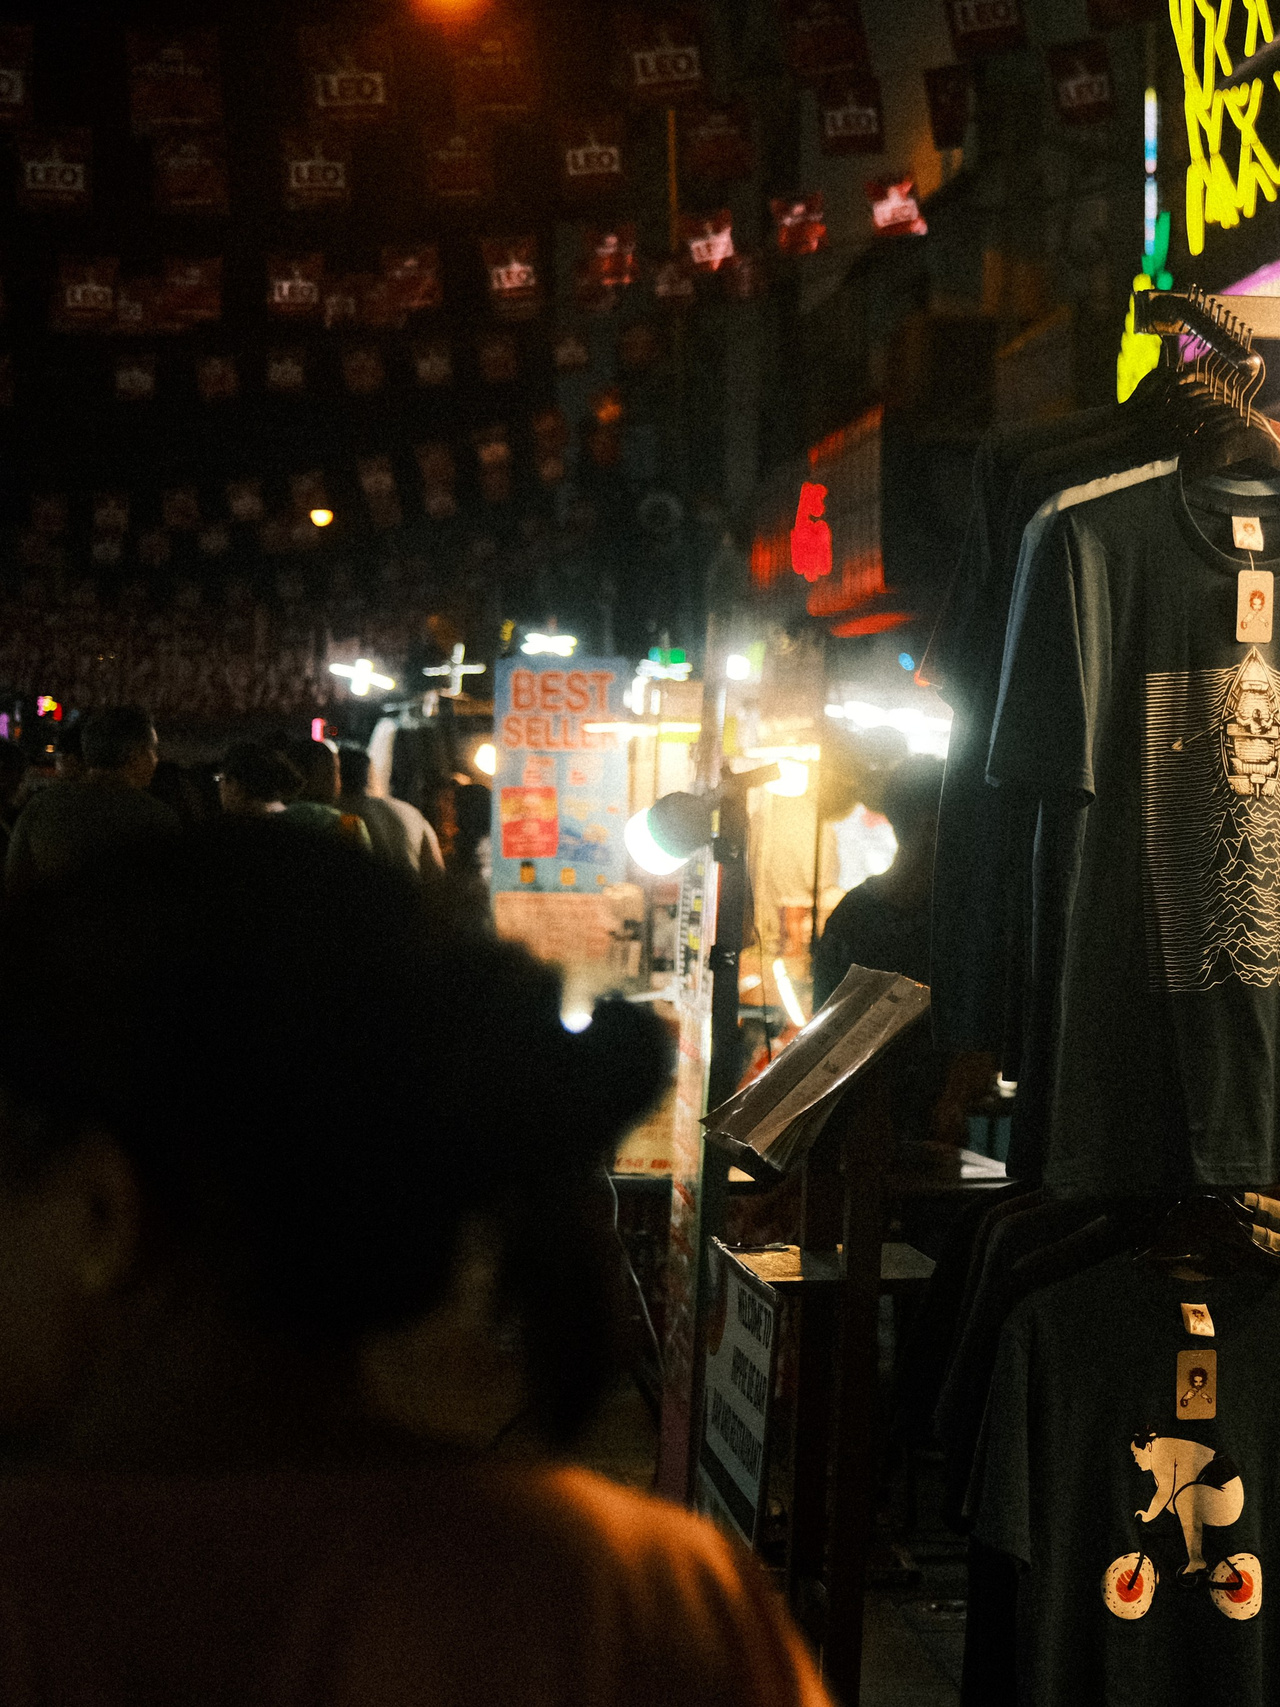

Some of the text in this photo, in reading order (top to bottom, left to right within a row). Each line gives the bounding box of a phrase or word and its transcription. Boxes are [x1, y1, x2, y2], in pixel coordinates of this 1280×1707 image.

[961, 1, 1009, 28] LEO
[640, 52, 696, 80] LEO
[322, 74, 378, 102] LEO
[832, 111, 874, 131] LEO
[570, 151, 616, 173] LEO
[30, 165, 80, 187] LEO
[293, 163, 342, 186] LEO
[494, 269, 534, 287] LEO
[277, 283, 317, 300] LEO
[511, 669, 616, 713] BEST
